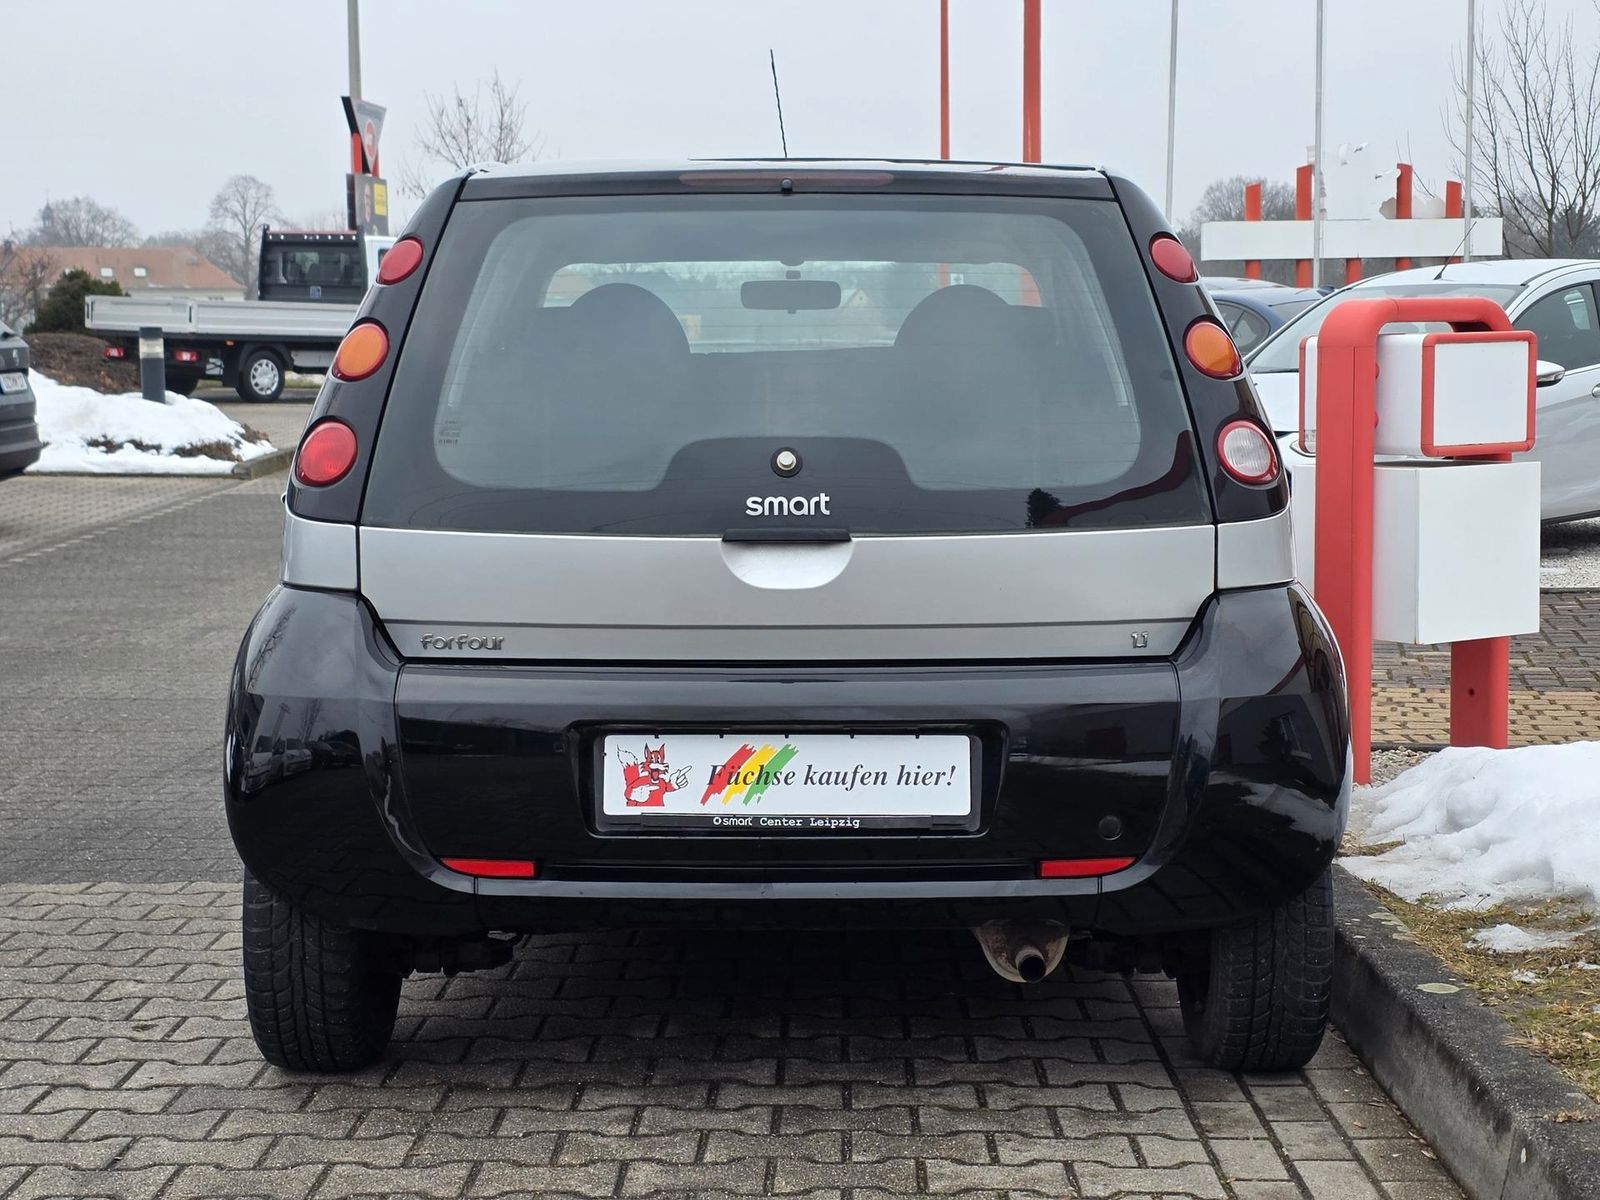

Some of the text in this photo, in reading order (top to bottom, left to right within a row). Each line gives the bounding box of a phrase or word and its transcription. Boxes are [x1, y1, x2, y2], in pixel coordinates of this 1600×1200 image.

[745, 492, 831, 516] smart
[706, 764, 957, 791] Füchse kaufen hier!
[722, 816, 861, 829] smart Center Leipzig
